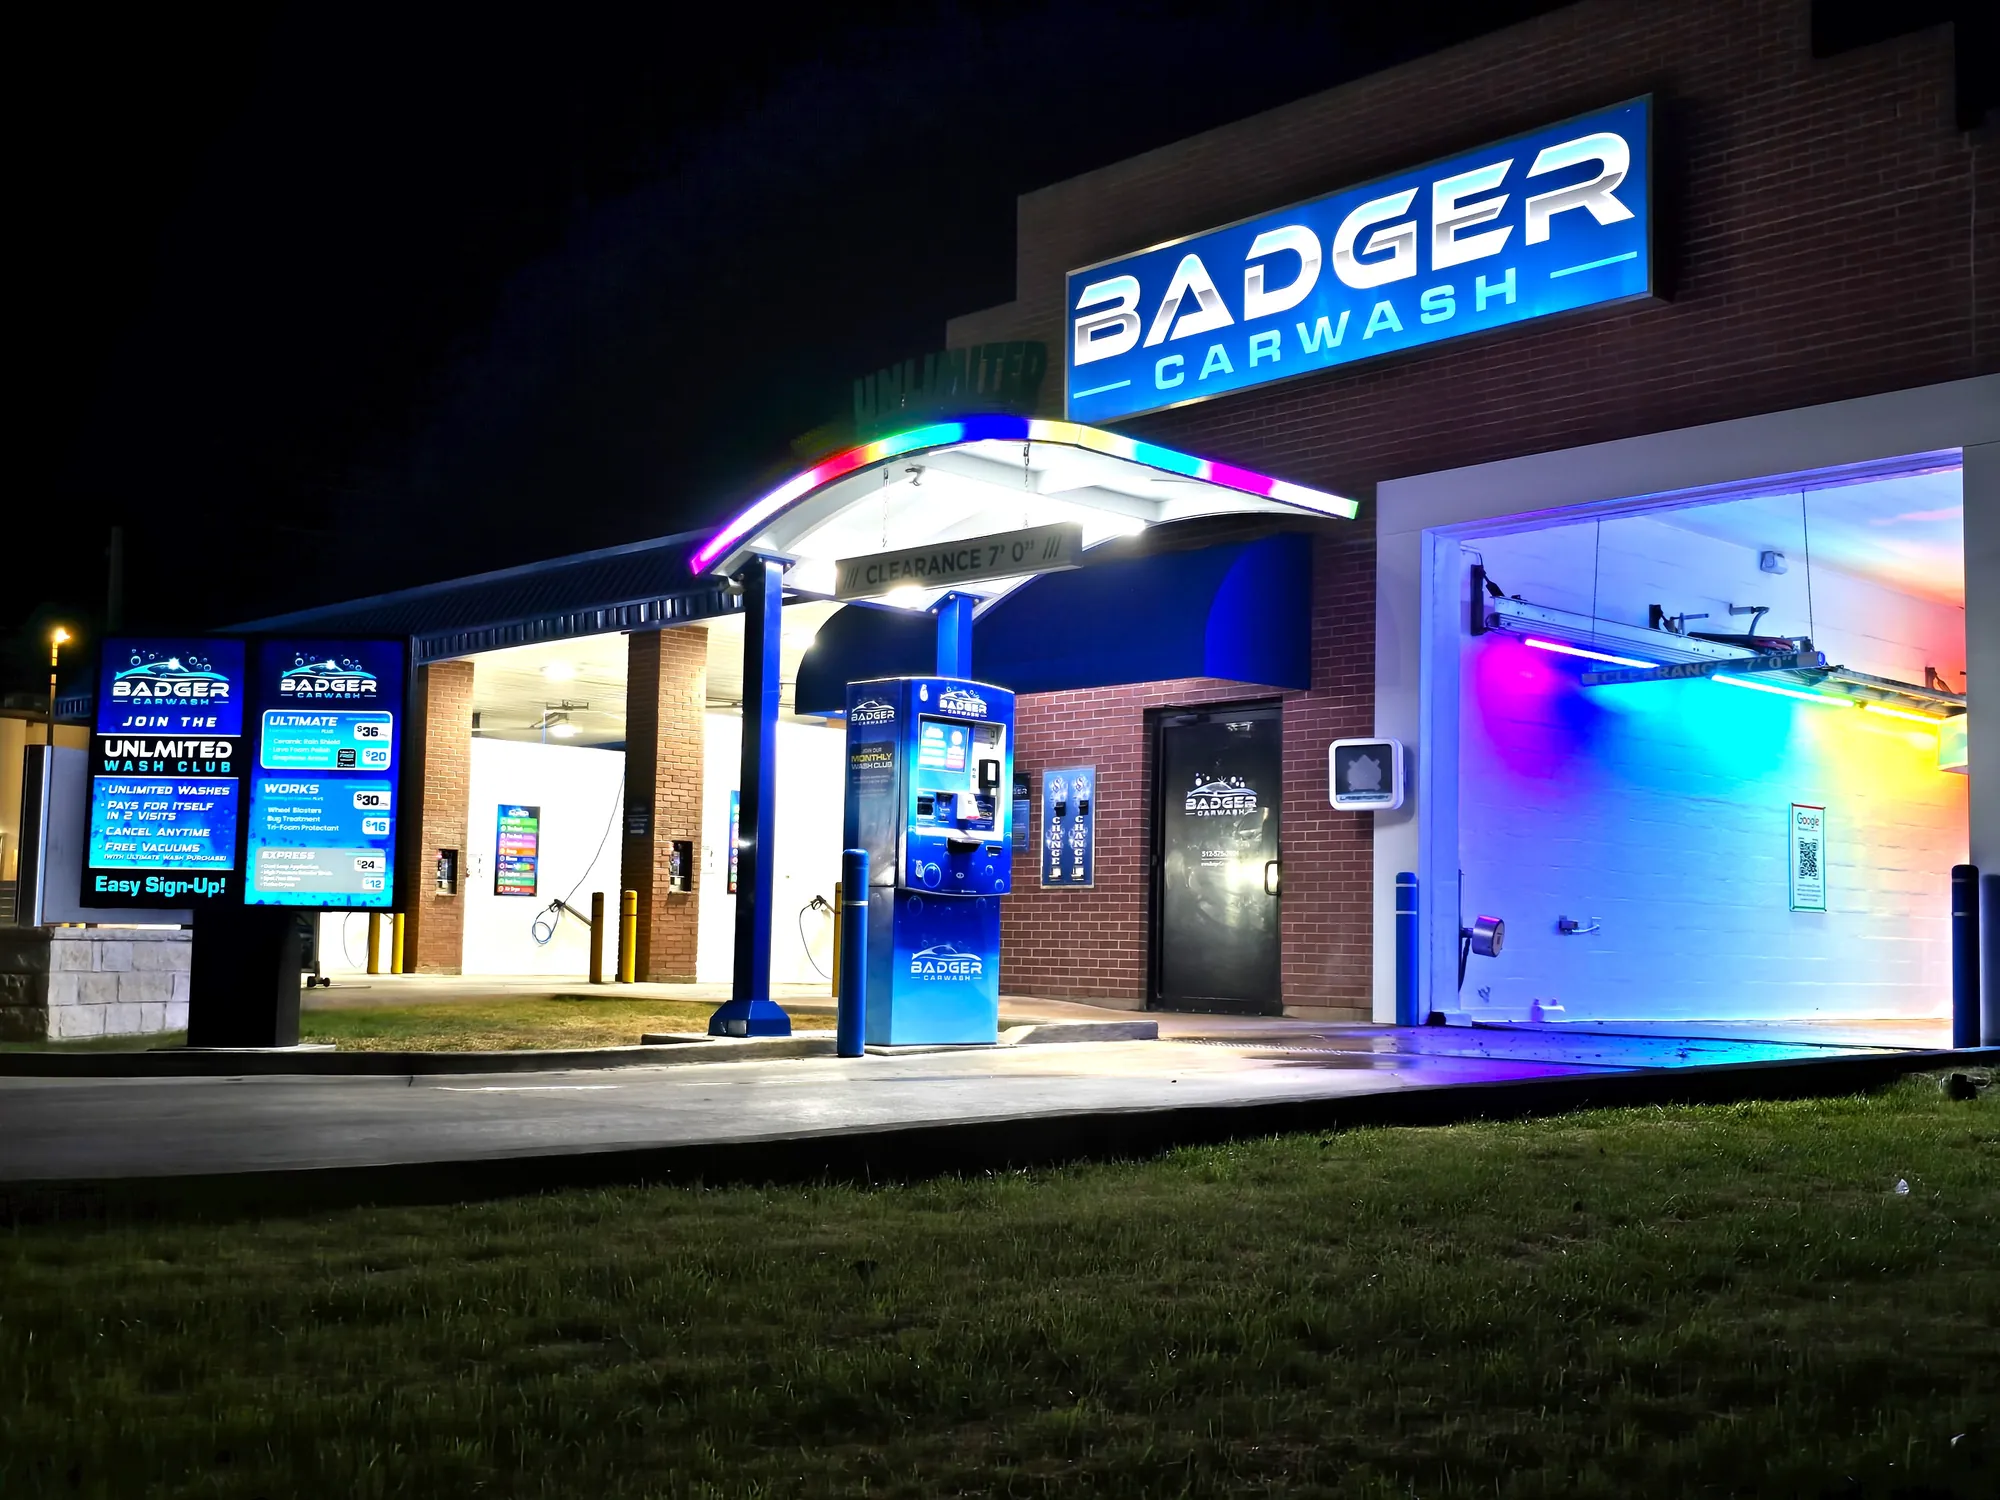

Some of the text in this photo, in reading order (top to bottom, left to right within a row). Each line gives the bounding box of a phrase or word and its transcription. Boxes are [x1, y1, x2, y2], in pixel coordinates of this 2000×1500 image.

[1074, 131, 1635, 367] BADGER
[1154, 267, 1517, 391] CARWASH
[866, 548, 982, 585] CLEARANCE
[113, 681, 230, 698] BADGER
[280, 679, 377, 692] BADGER
[133, 698, 210, 706] CARWASH
[939, 699, 987, 714] BADGER
[122, 716, 217, 727] JOIN THE
[269, 715, 339, 727] ULTIMATE
[851, 710, 895, 722] BADGER
[356, 725, 379, 738] $36
[365, 751, 387, 762] $20
[851, 753, 892, 763] MONTHLY
[104, 760, 231, 773] WASH CLUB
[851, 761, 893, 770] WASH CLUB
[108, 785, 230, 796] UNLIMITED WASHES
[264, 783, 320, 794] WORKS
[107, 800, 214, 811] PAYS FOR ITSELF
[356, 793, 380, 806] $30
[1185, 796, 1257, 810] BADGER
[106, 811, 177, 821] IN 2 VISITS
[282, 815, 321, 823] Treatment
[1797, 812, 1820, 828] Google
[105, 826, 211, 837] CANCEL ANYTIME
[365, 820, 387, 832] $16
[1051, 816, 1061, 865] CHANGE
[1074, 815, 1084, 864] CHANGE
[104, 842, 200, 852] FREE VACUUMS
[262, 851, 316, 860] EXPRESS
[95, 875, 226, 898] Easy Sign-Up!
[910, 961, 983, 974] BADGER
